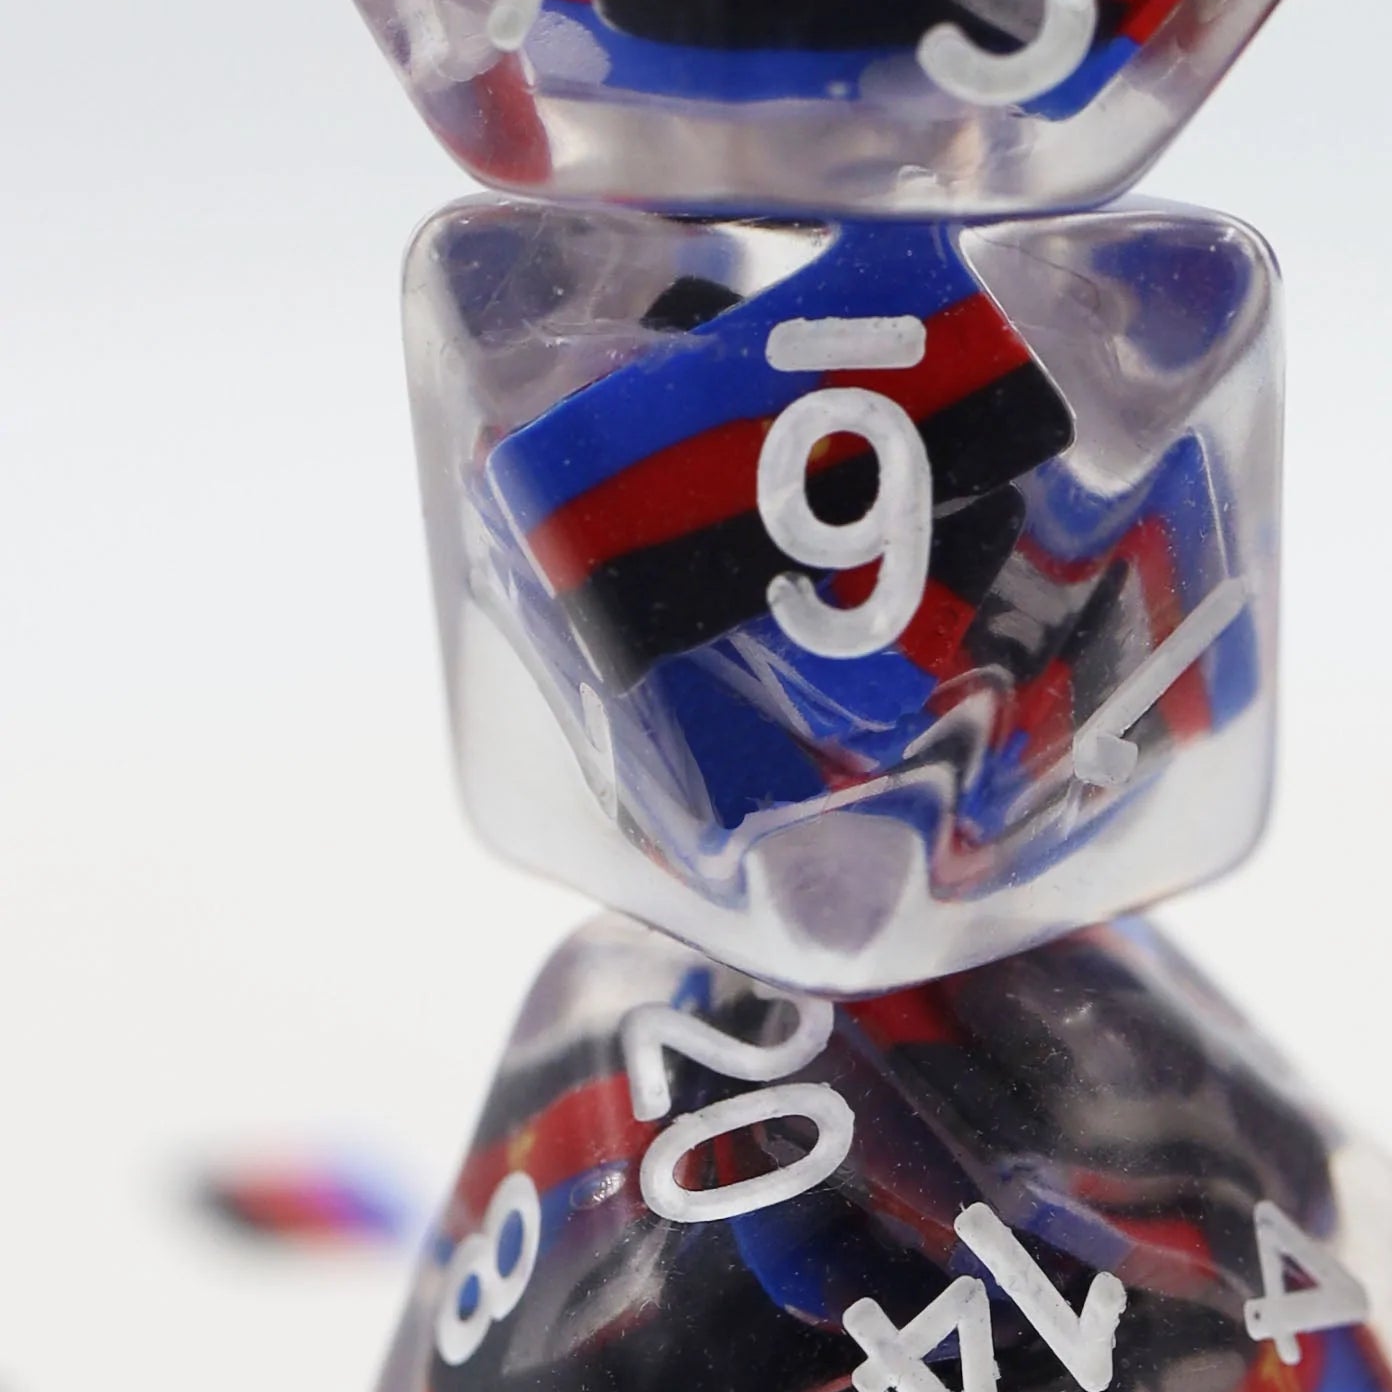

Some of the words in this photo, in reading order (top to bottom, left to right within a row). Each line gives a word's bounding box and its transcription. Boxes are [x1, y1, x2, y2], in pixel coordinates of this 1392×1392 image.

[620, 999, 854, 1223] 20
[437, 1172, 539, 1366] 8
[1244, 1200, 1369, 1364] 4
